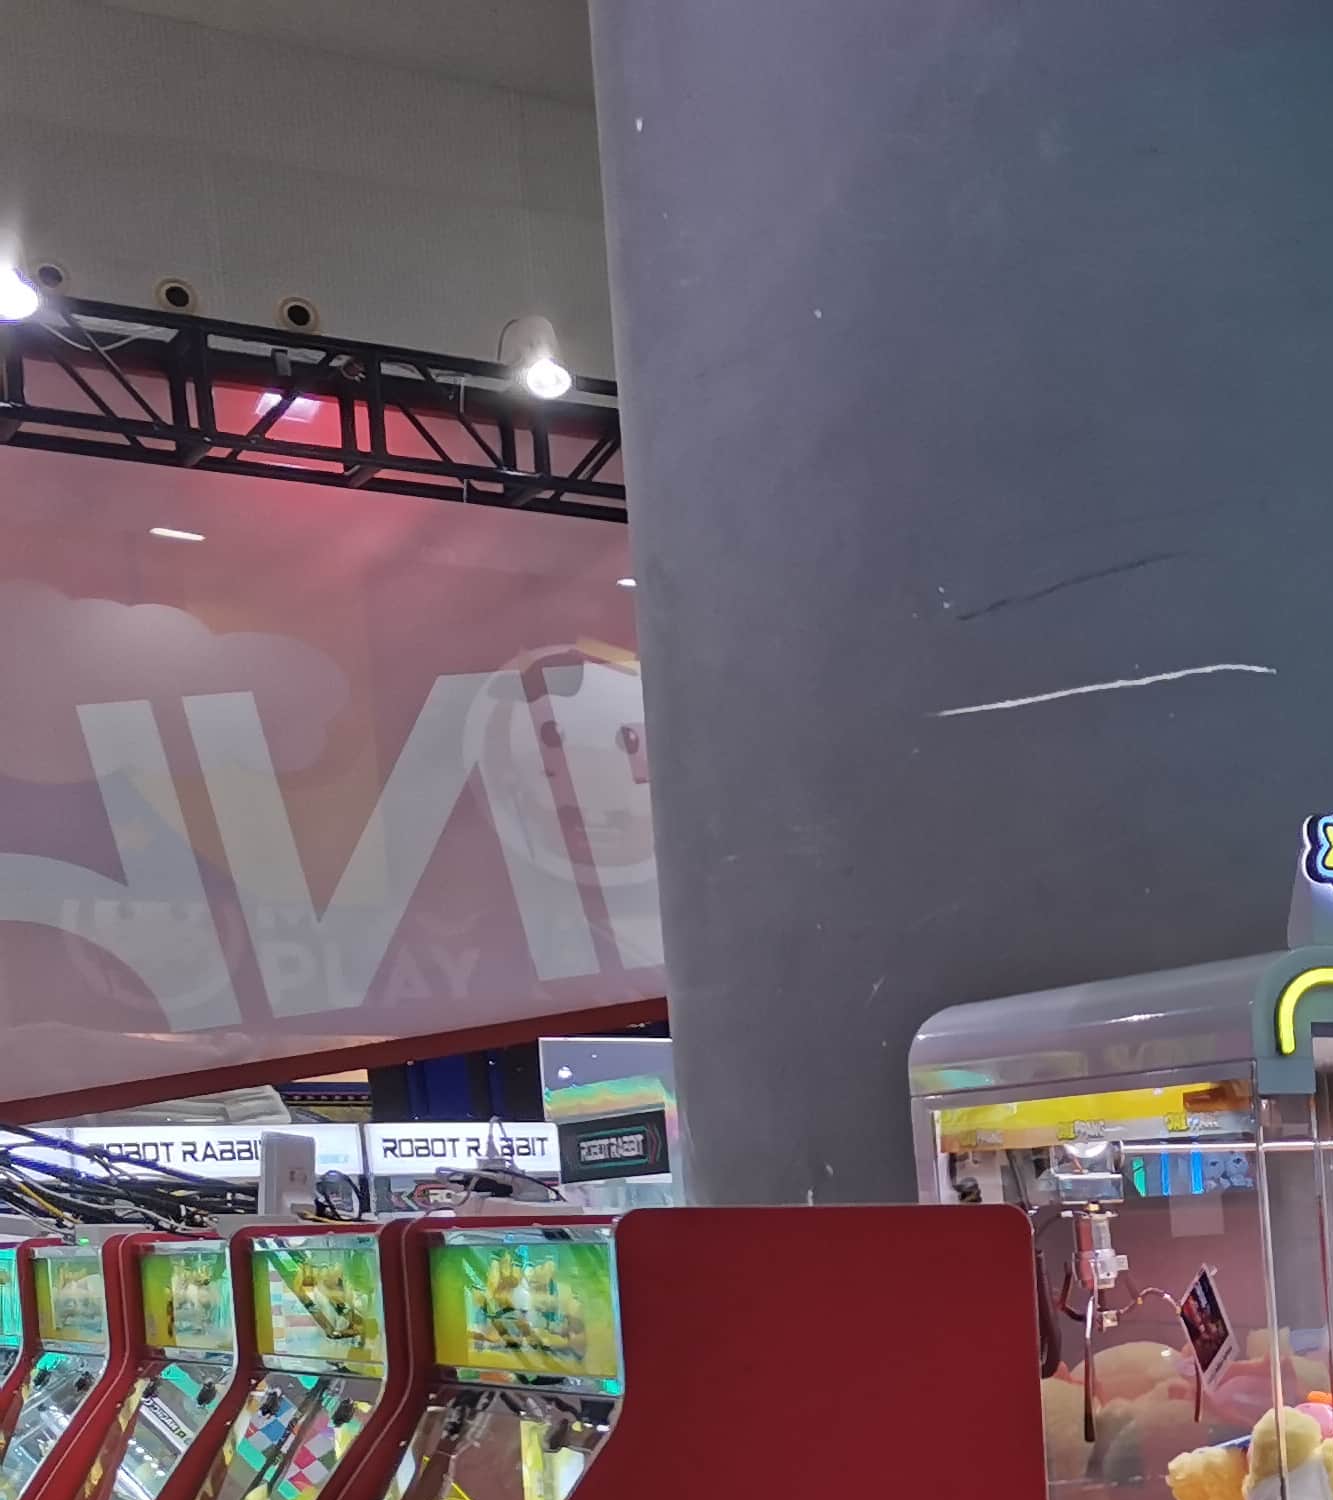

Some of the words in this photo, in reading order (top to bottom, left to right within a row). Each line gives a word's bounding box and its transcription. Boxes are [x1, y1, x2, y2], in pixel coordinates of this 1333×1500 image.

[97, 1142, 174, 1164] OBOT
[182, 1139, 264, 1163] RABBI
[382, 1138, 460, 1159] ROBOT
[466, 1137, 549, 1158] RBBIT
